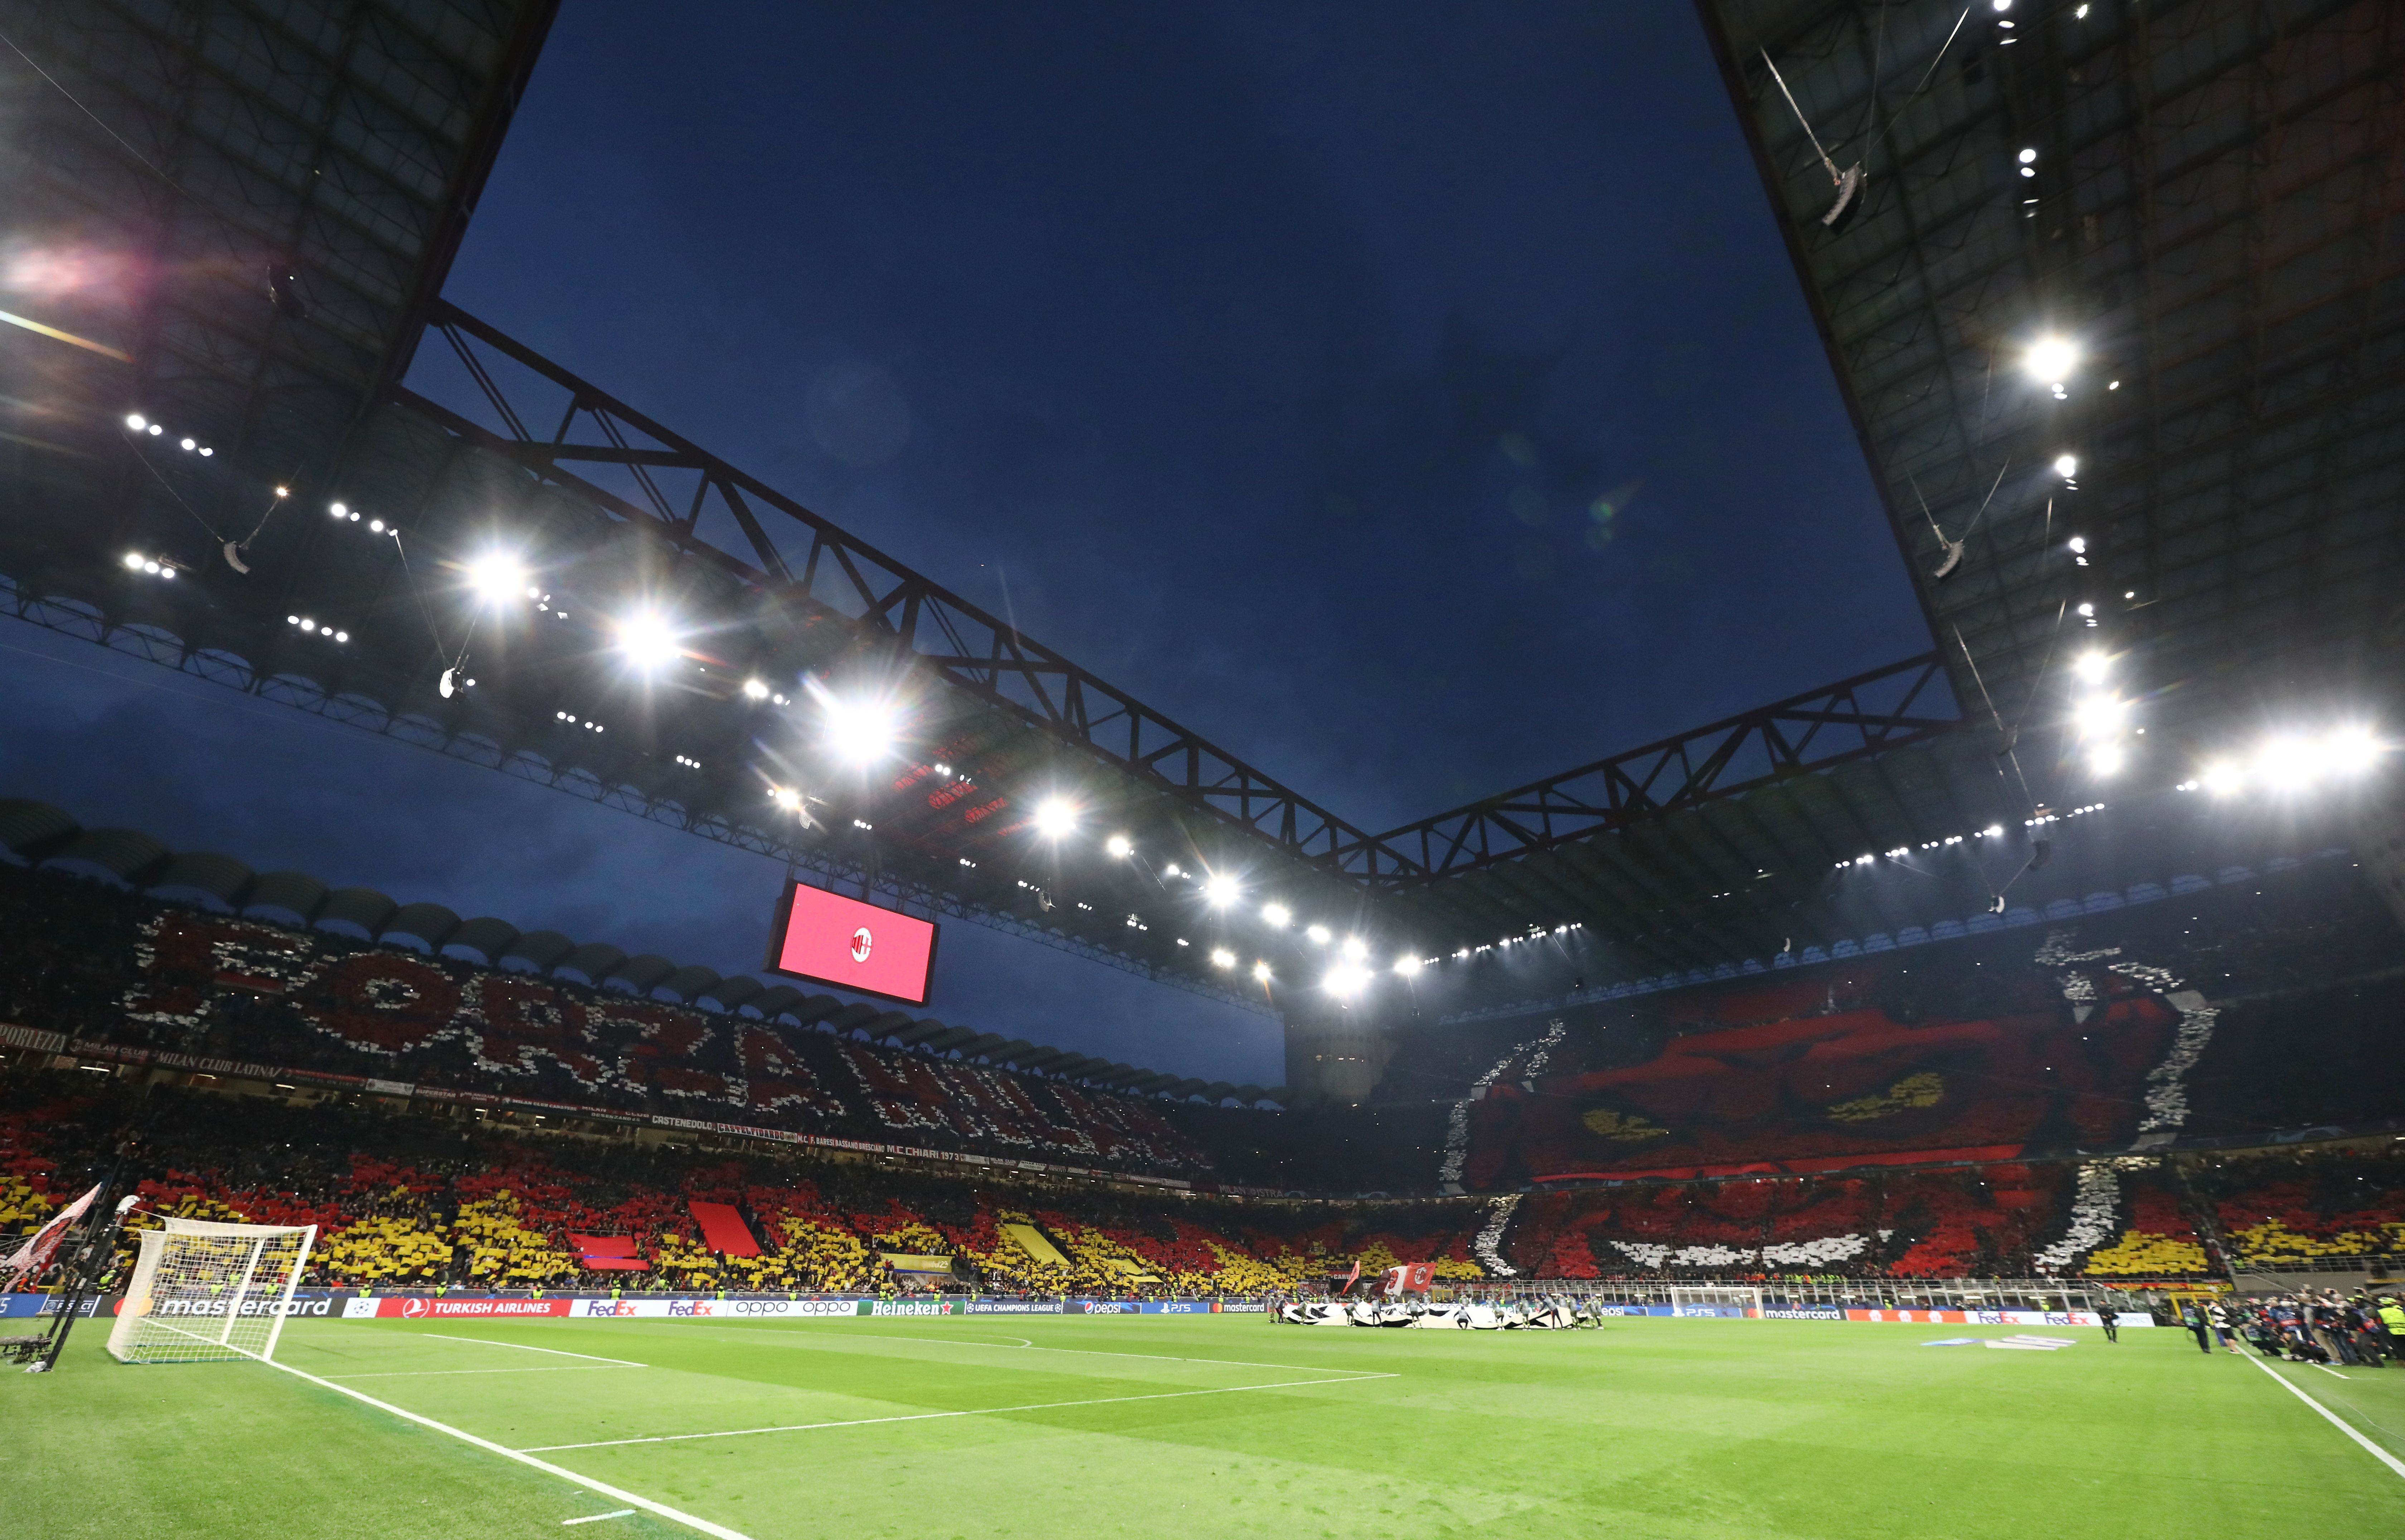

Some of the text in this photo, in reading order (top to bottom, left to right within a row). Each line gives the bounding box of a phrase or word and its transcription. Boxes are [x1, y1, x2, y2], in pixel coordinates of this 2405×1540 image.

[84, 1041, 148, 1056] MILAN CLUB
[156, 1051, 196, 1067] MILAN
[199, 1058, 233, 1071] CLUB
[234, 1062, 283, 1078] LATINA
[415, 1088, 456, 1098] SUPERSTAR
[816, 1137, 834, 1146] BARESI
[835, 1139, 858, 1149] BASSANO
[859, 1142, 884, 1153] BRESCIANO
[940, 1150, 959, 1161] 1973
[435, 1302, 550, 1314] TURKISH AIRLINES
[587, 1301, 637, 1316] FedEx
[669, 1301, 713, 1315] FedEx
[736, 1302, 788, 1316] oppo
[803, 1302, 850, 1315] oppo
[871, 1301, 940, 1315] Heineken
[1094, 1302, 1121, 1314] pepsi
[1171, 1304, 1191, 1312] PS5
[1224, 1303, 1264, 1312] mastercard
[1601, 1306, 1624, 1316] epsi
[1686, 1308, 1716, 1317] PS5
[1765, 1309, 1841, 1320] mastercard
[1978, 1311, 2021, 1324] FedEx
[2045, 1312, 2091, 1325] FedEx
